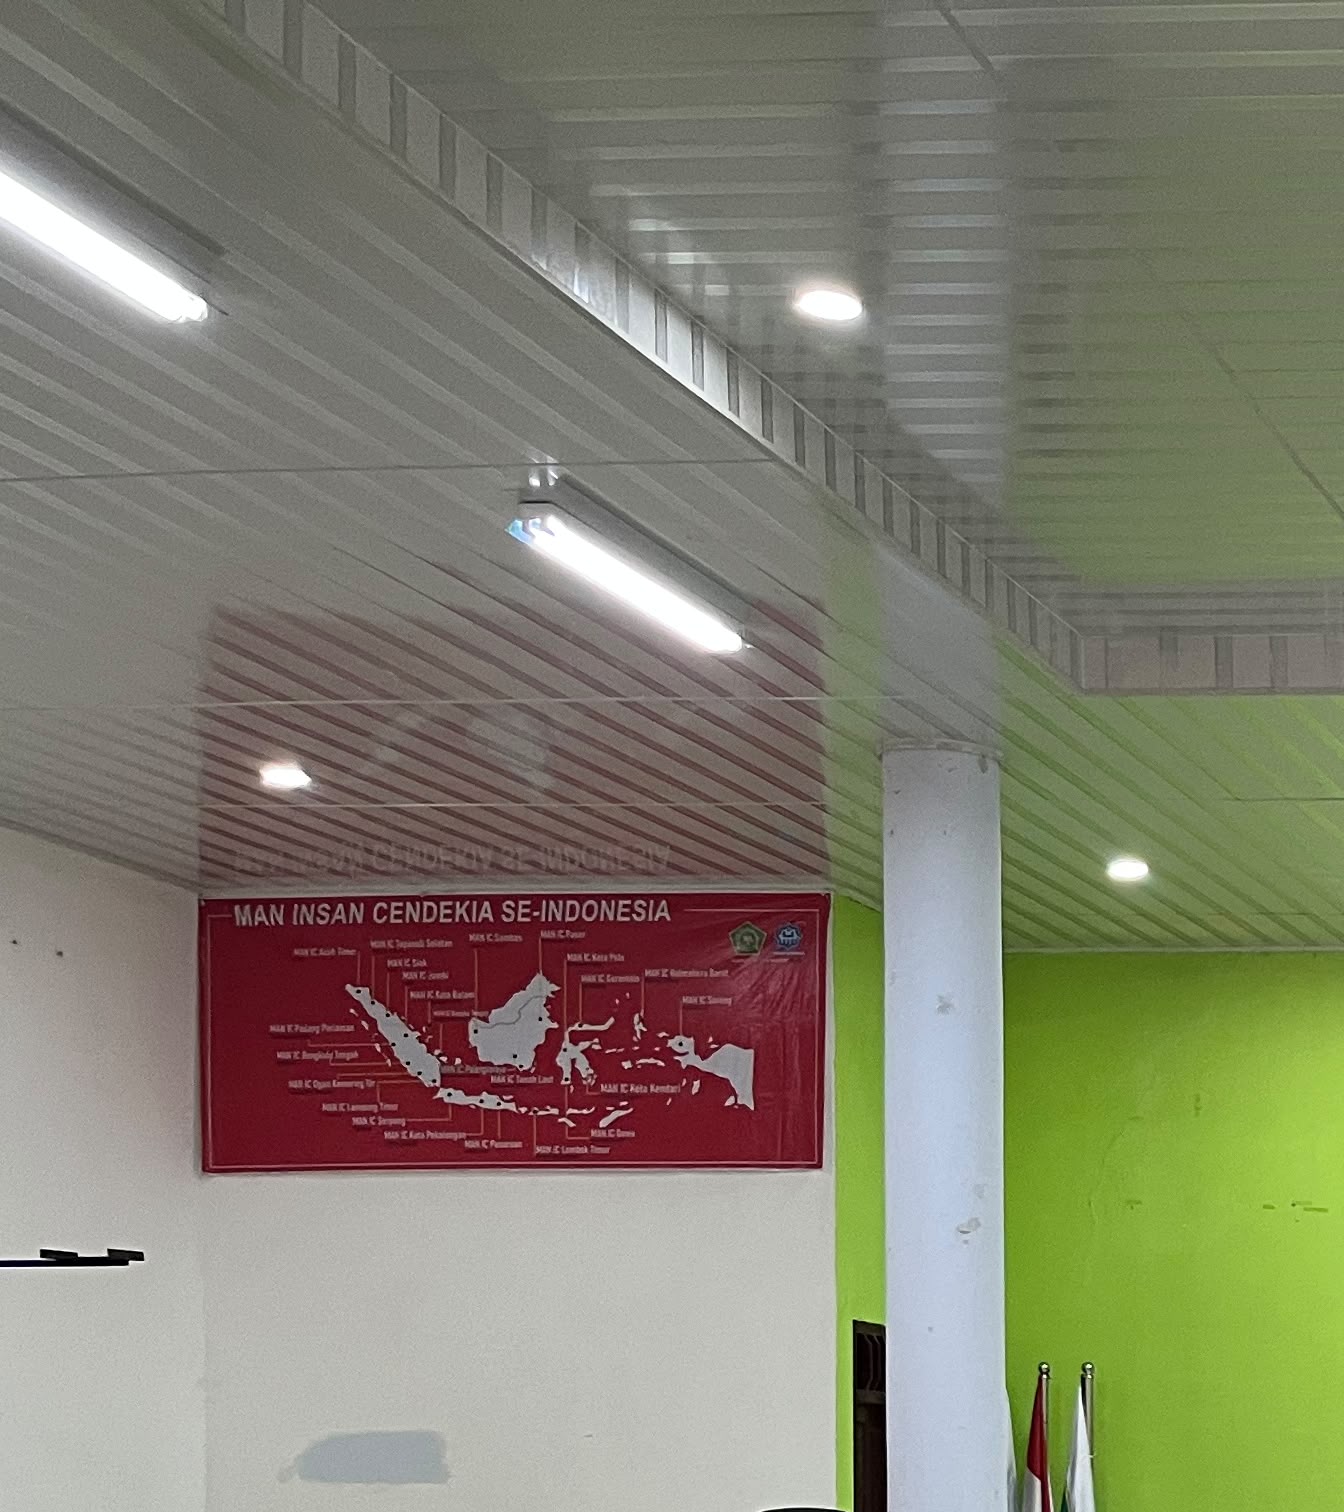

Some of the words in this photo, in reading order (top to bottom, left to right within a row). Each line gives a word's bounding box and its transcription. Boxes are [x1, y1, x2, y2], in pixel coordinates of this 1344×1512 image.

[234, 903, 284, 927] MAN
[292, 902, 364, 926] INSAN
[372, 900, 494, 924] CENDEKIA
[501, 899, 672, 922] SE-INDONESIA
